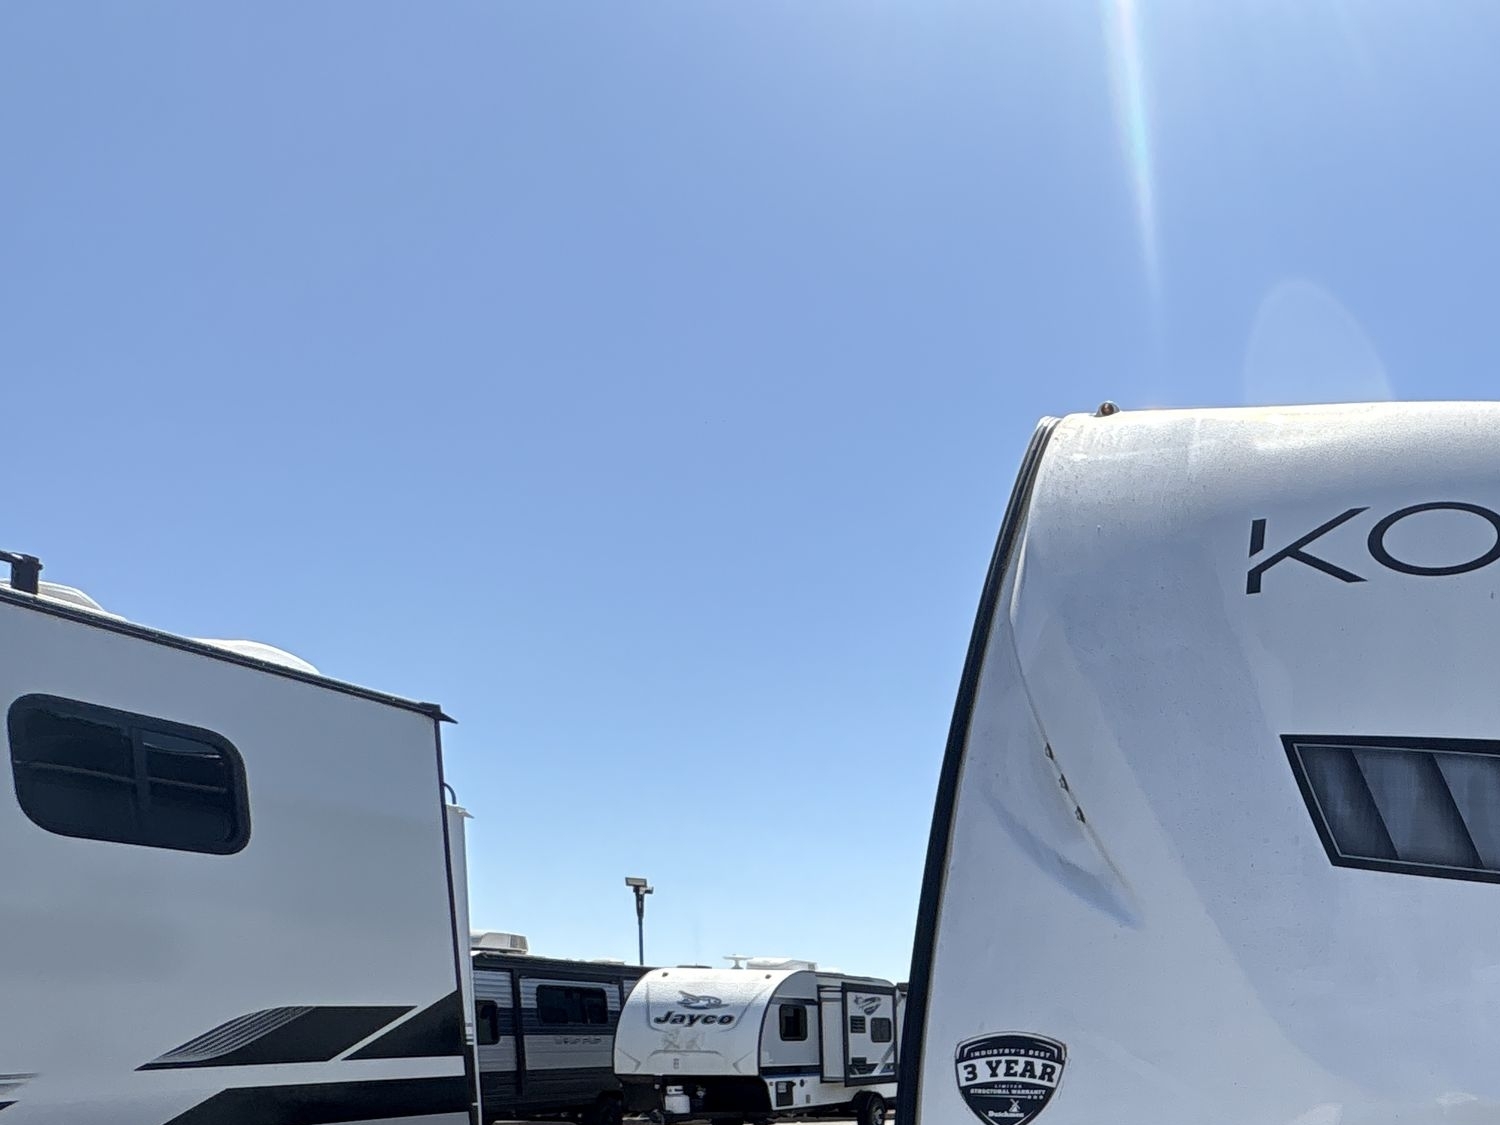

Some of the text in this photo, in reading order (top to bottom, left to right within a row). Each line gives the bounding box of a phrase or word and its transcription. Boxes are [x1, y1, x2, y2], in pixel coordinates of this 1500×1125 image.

[653, 1010, 735, 1028] Jayco
[970, 1048, 1051, 1058] INDUSTRY'S BEST
[963, 1059, 1056, 1083] 3 YEAR
